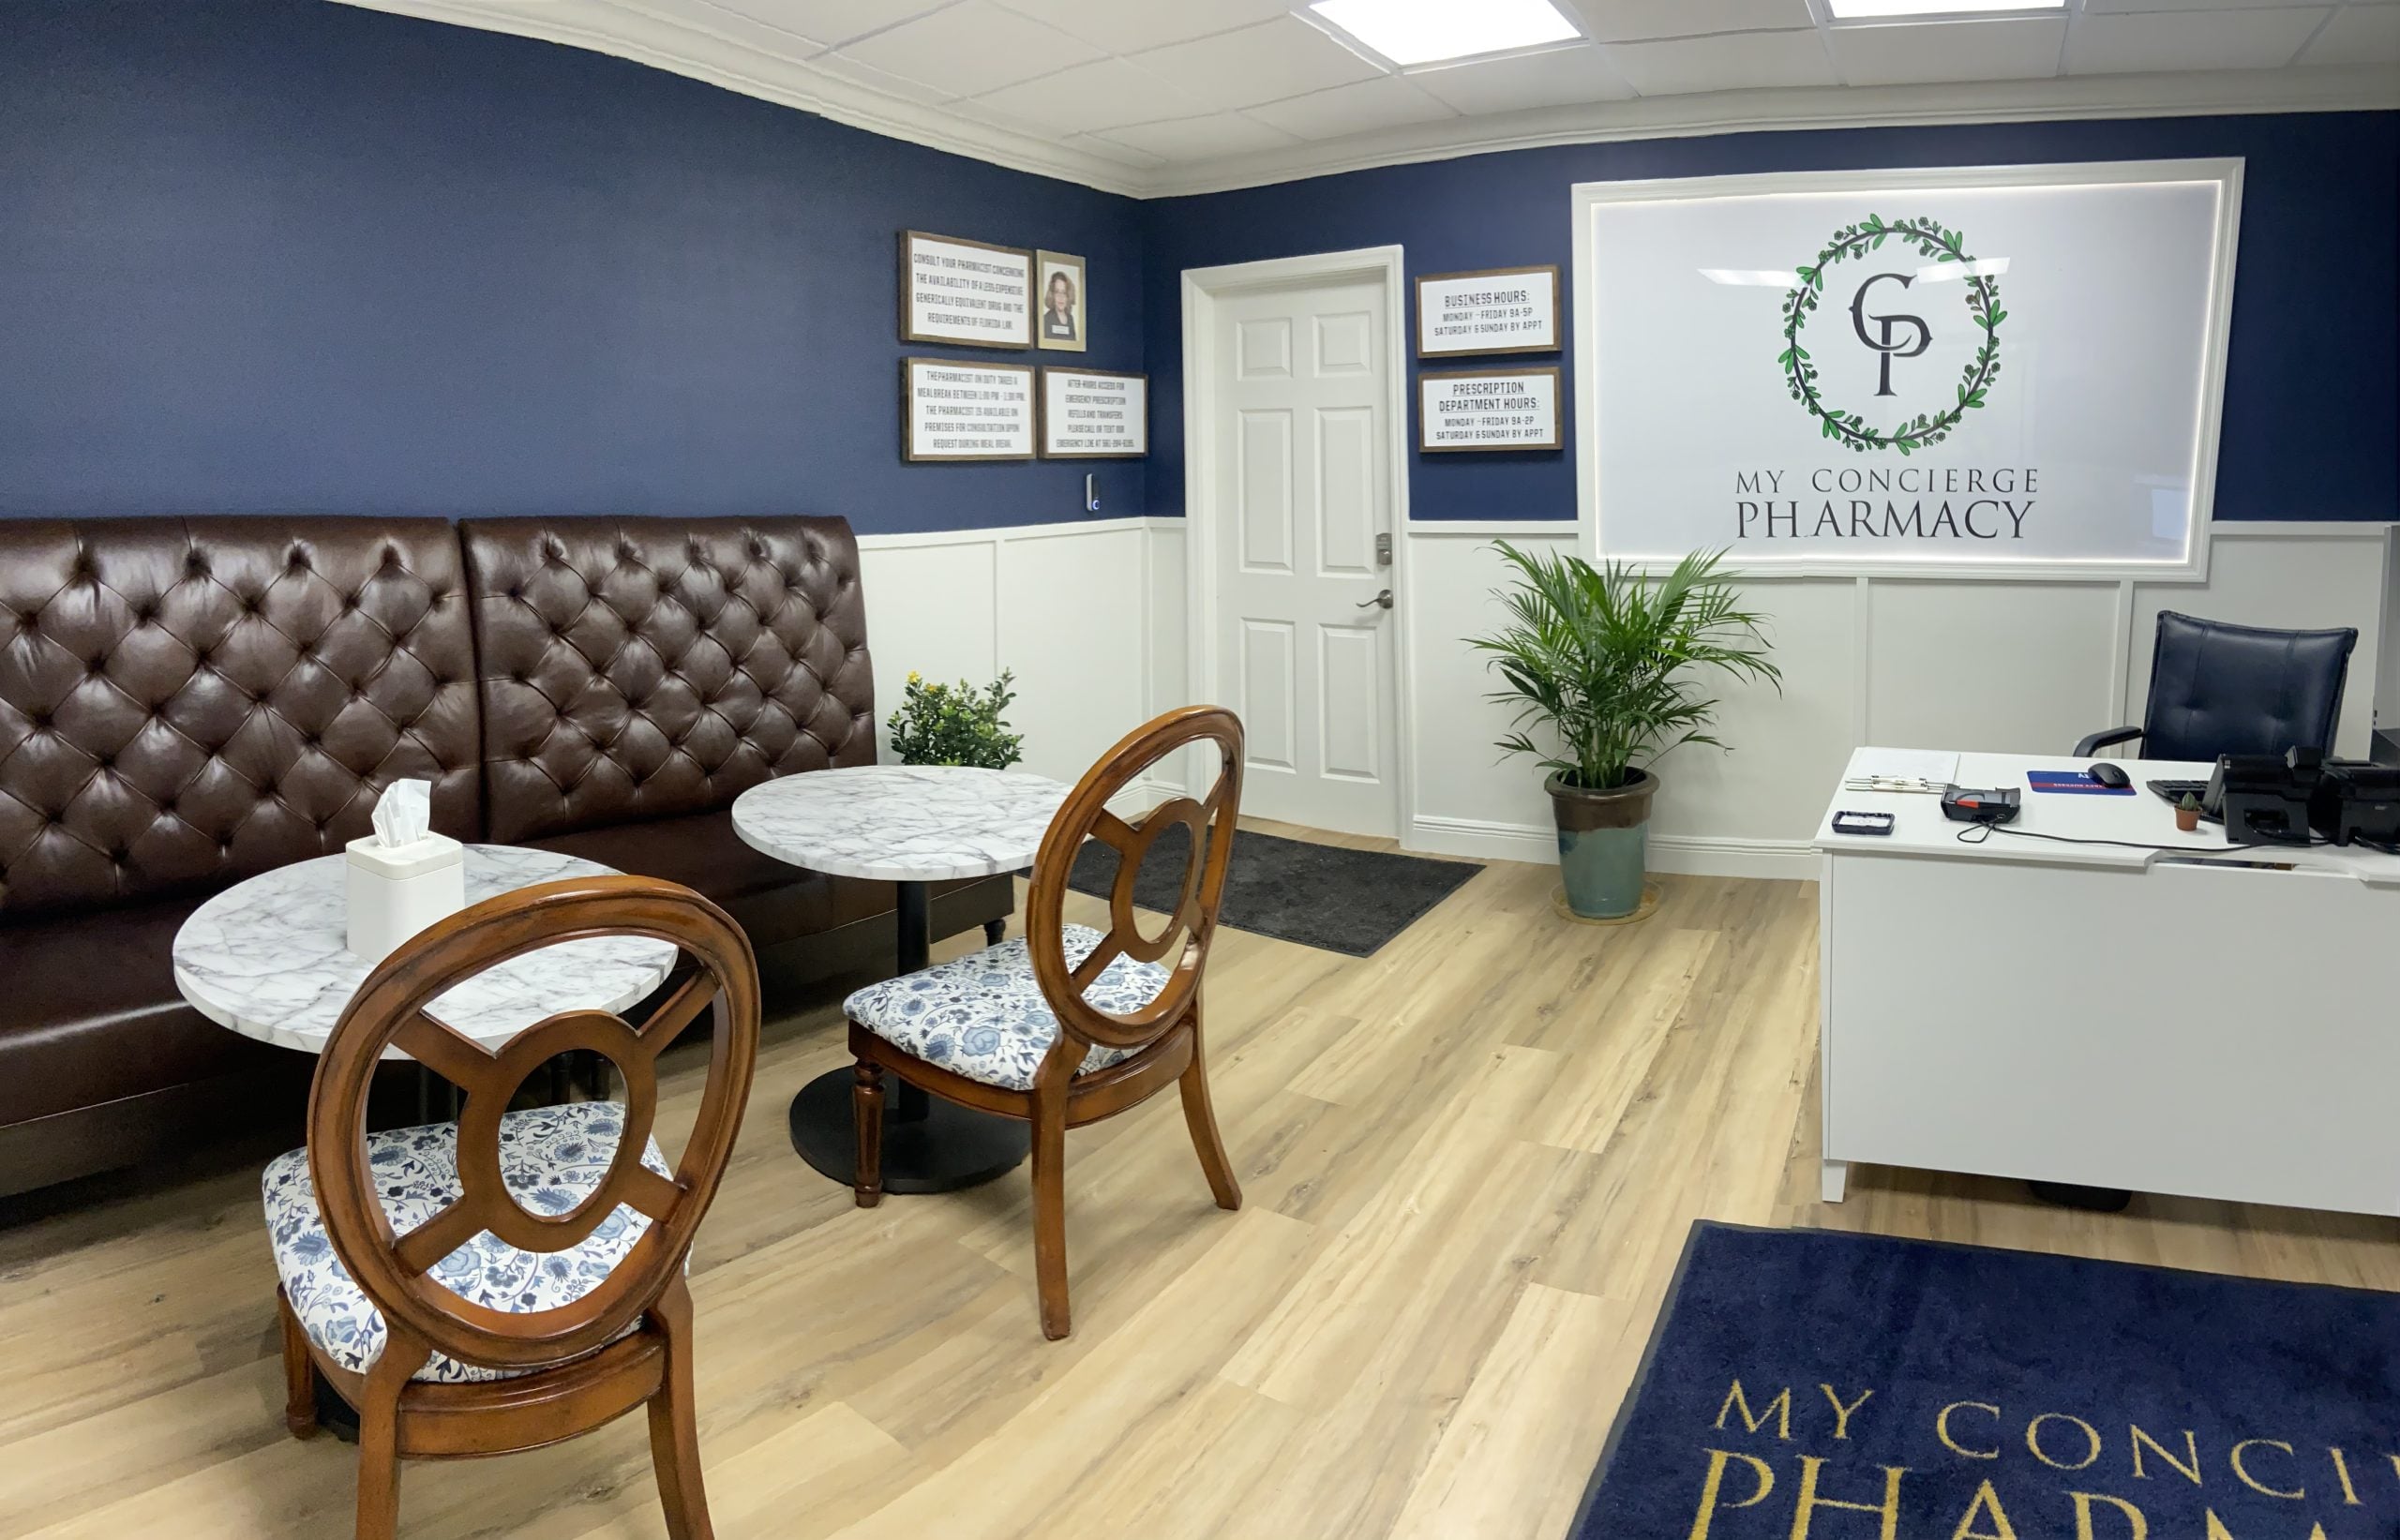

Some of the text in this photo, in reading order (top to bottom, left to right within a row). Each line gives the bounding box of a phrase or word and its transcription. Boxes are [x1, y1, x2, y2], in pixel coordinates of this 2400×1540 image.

[914, 253, 939, 266] CONSULT
[942, 256, 956, 268] YOUR
[957, 259, 992, 273] PHARMACIST
[916, 273, 927, 284] THE
[928, 275, 969, 289] AVAILABILITY
[971, 280, 979, 290] OF
[916, 292, 954, 307] GENERICALLY
[1445, 291, 1530, 307] BUSINESS HOURS:
[927, 312, 971, 326] REQUIREMENTS
[1443, 311, 1473, 322] MONDAY
[1481, 308, 1508, 320] FRIDAY
[1509, 307, 1534, 318] 9A-5P
[1434, 320, 1542, 336] SATURDAY & SUNDAY BY APPT
[927, 370, 938, 381] THE
[938, 371, 973, 383] PHARMACIST
[917, 387, 933, 397] MEAL
[934, 388, 952, 399] BREAK
[1453, 381, 1524, 396] PRESCRIPTION
[926, 405, 937, 415] THE
[938, 405, 974, 416] PHARMACIST
[1439, 397, 1539, 411] DEPARTMENT HOURS:
[924, 422, 954, 432] PREMISES
[1445, 418, 1475, 427] MONDAY
[1482, 416, 1509, 426] FRIDAY
[1511, 415, 1535, 426] 9A-2P
[1436, 428, 1544, 440] SATURDAY & SUNDAY BY APPT
[933, 439, 957, 449] REQUEST
[1735, 468, 2038, 494] MY CONCIERGE
[1735, 499, 2036, 539] PHARMACY
[1712, 1379, 1875, 1441] MY
